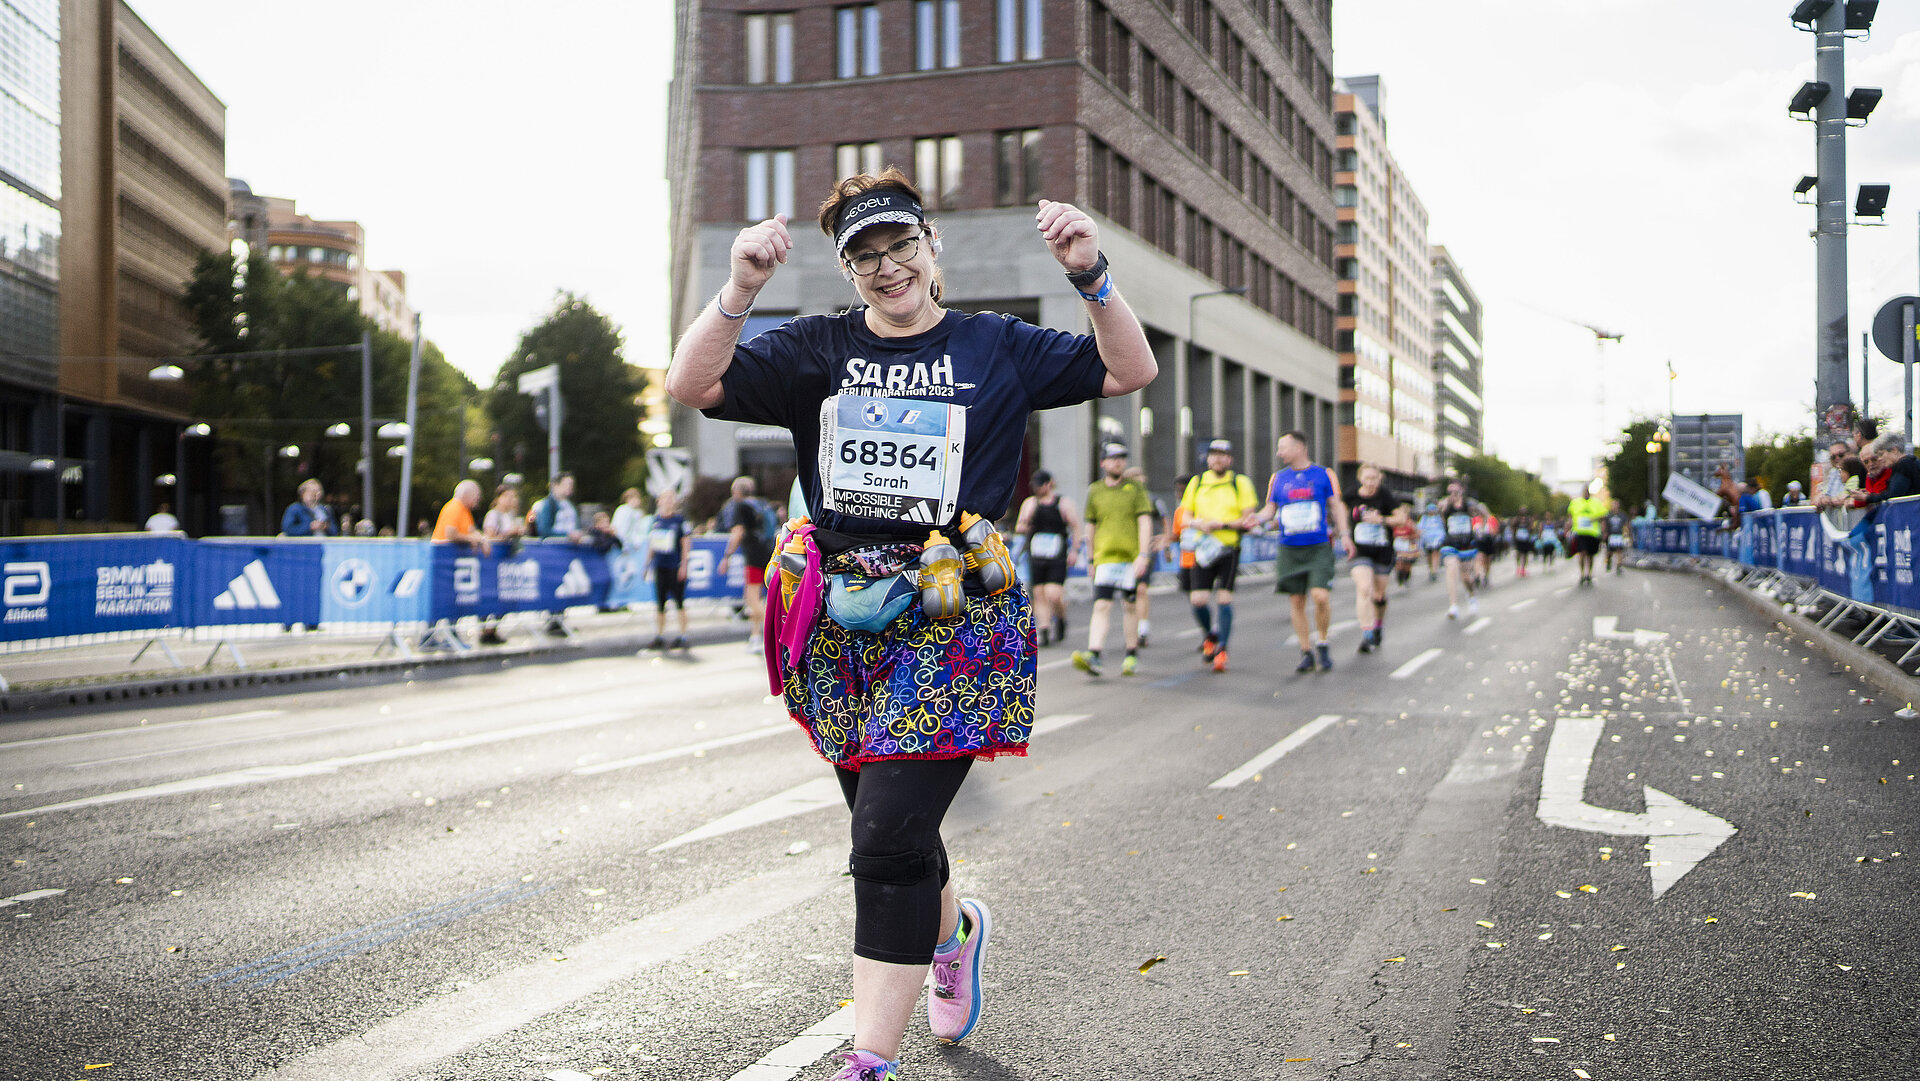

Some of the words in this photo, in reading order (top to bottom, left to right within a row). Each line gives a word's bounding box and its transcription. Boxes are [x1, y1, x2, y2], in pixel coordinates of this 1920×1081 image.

[847, 197, 891, 219] coeur
[841, 354, 954, 390] SARAH
[838, 386, 872, 397] BERLIN
[873, 386, 927, 398] MARATHON
[929, 385, 954, 397] 2023
[840, 439, 936, 471] 68364
[951, 442, 960, 454] K
[863, 472, 908, 489] Sarah
[834, 489, 903, 508] IMPOSSIBLE
[835, 501, 844, 513] IS
[845, 504, 898, 520] NOTHING
[97, 565, 147, 585] BMW
[96, 585, 146, 599] BERLIN
[95, 598, 173, 617] MARATHON
